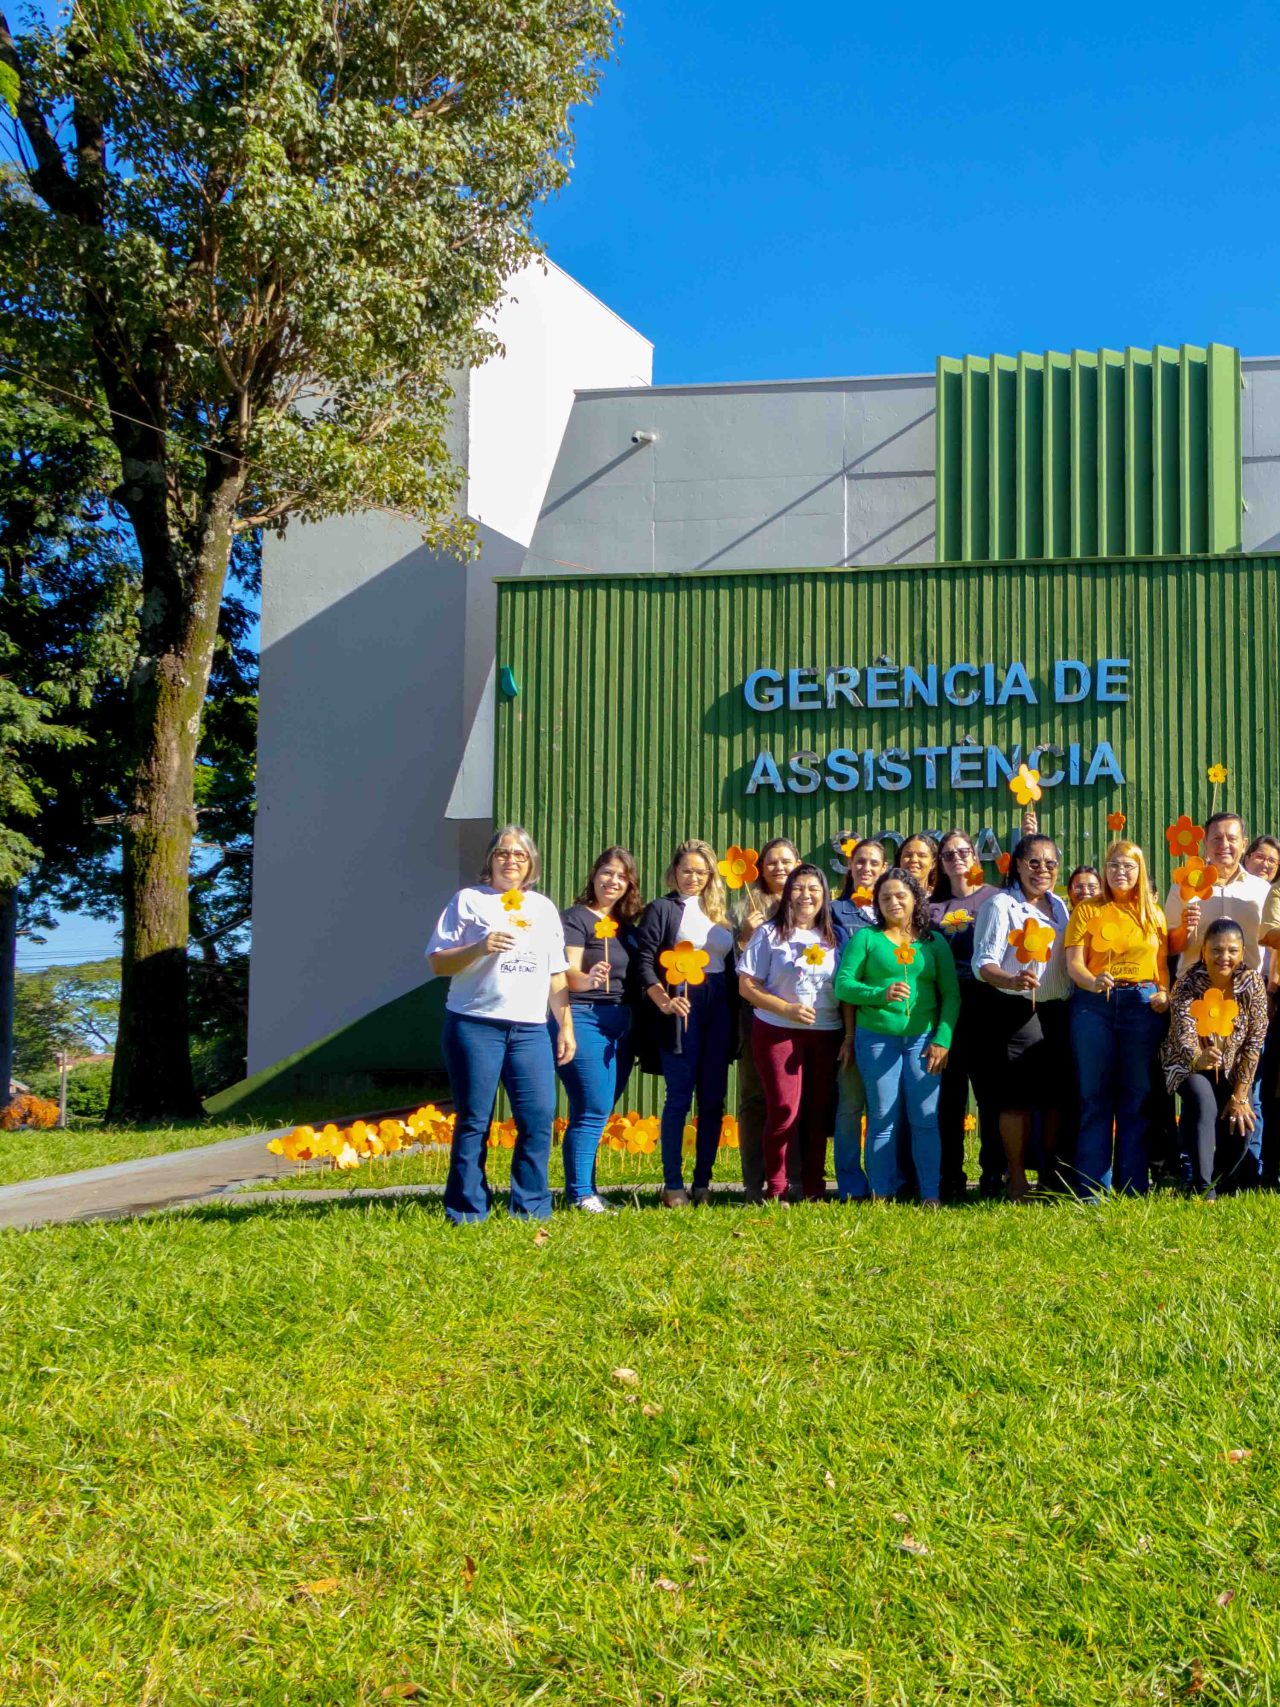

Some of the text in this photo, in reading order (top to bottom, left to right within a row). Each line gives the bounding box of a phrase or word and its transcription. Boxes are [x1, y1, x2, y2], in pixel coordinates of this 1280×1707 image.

[744, 654, 1131, 712] GERÊNCIA DE
[745, 734, 1126, 794] ASSISTÊNCIA
